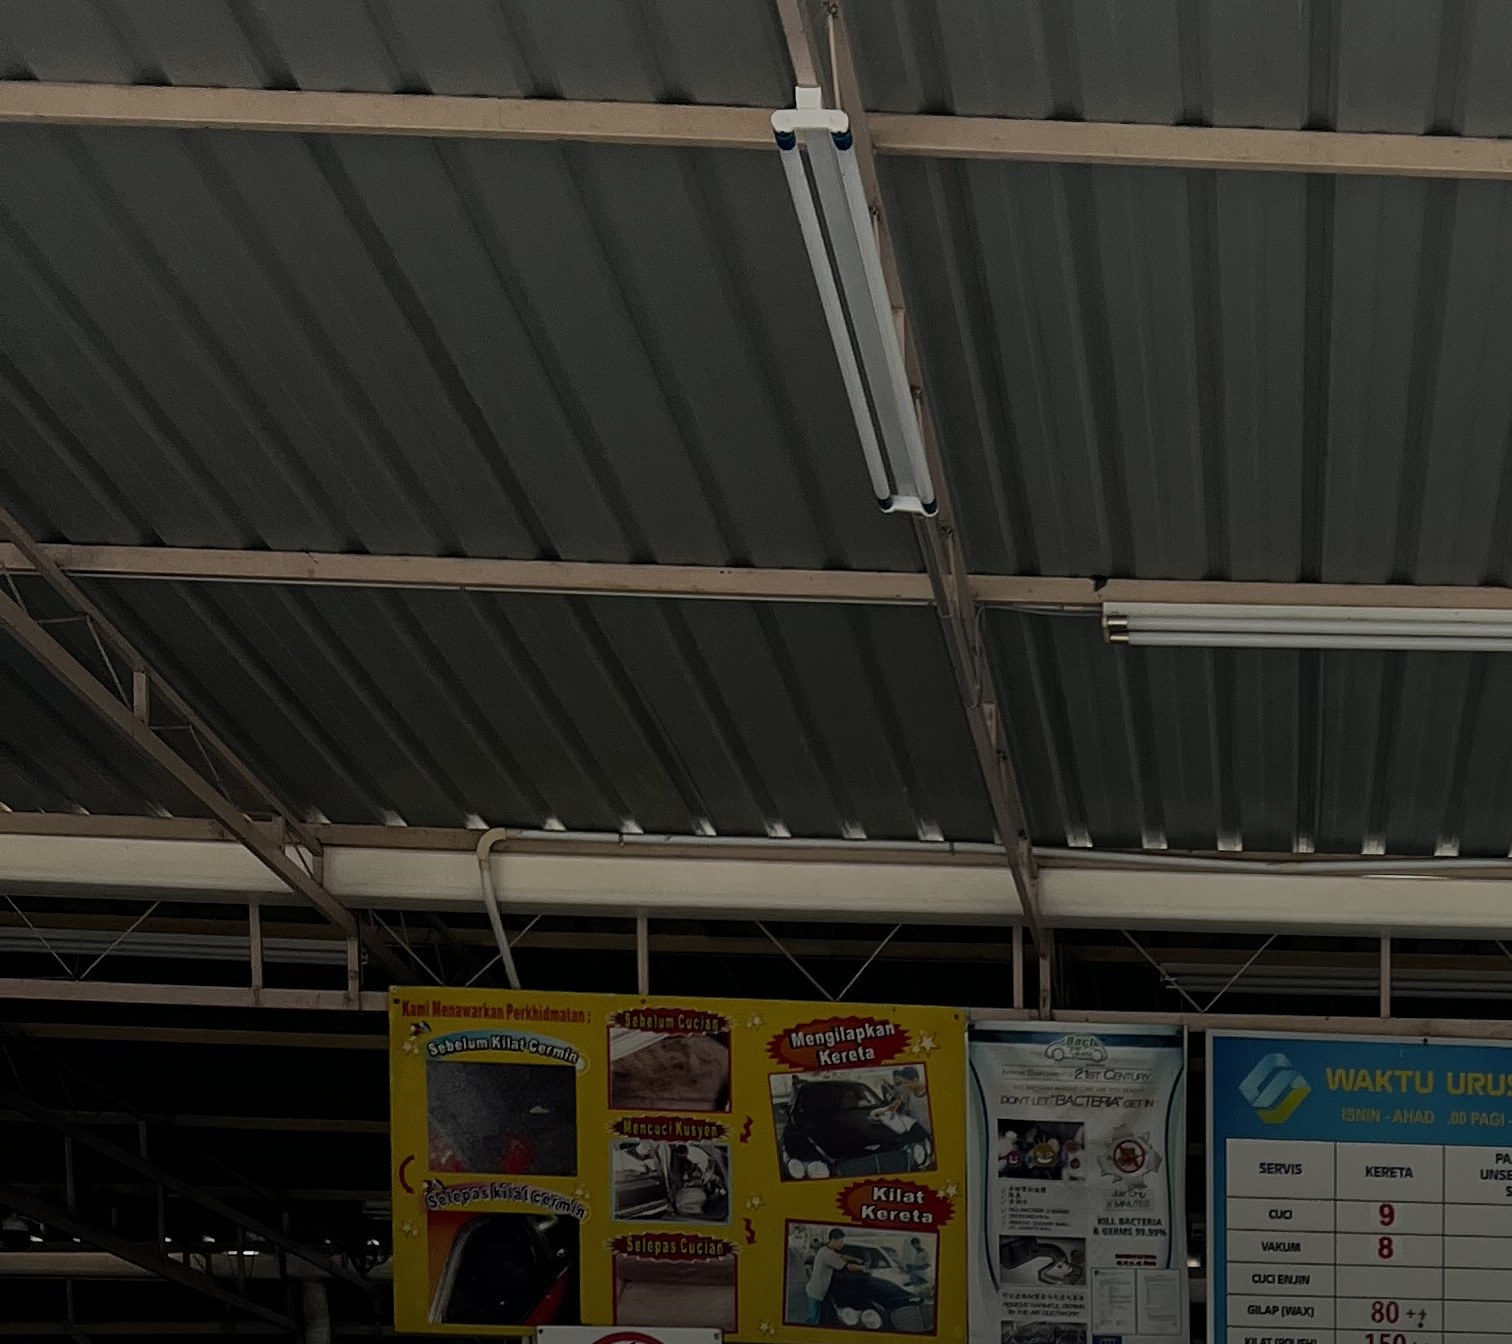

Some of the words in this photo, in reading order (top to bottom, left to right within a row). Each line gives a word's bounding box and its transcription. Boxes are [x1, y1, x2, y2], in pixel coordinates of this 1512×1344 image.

[402, 1000, 430, 1018] Kami
[432, 1001, 503, 1021] Menawarkan
[506, 1003, 585, 1023] Perkhidmatan
[624, 1013, 675, 1031] Sebelum
[677, 1015, 720, 1032] Cucian
[790, 1022, 896, 1049] Mengilapkan
[427, 1036, 489, 1057] Sebelum
[491, 1034, 527, 1051] Kilat
[528, 1040, 579, 1065] Cermin
[818, 1045, 876, 1067] Kereta
[1325, 1067, 1435, 1094] WAKTU
[1341, 1107, 1381, 1122] ISNIN
[1391, 1109, 1435, 1124] AHAD
[1471, 1111, 1505, 1126] PAGI
[622, 1119, 673, 1136] Mencuci
[675, 1121, 718, 1141] Kusyen
[1258, 1162, 1303, 1176] SERVIS
[1364, 1166, 1414, 1179] KERETA
[427, 1184, 489, 1209] Selepas
[872, 1185, 926, 1205] Kilat
[860, 1204, 934, 1225] Kereta
[1097, 1217, 1115, 1226] KILL
[1119, 1217, 1163, 1227] BACTERIA
[1268, 1209, 1293, 1220] CUCI
[1378, 1203, 1396, 1227] 9
[626, 1235, 677, 1255] Selepas
[679, 1237, 724, 1256] Cucian
[1261, 1241, 1302, 1253] VAKUM
[1377, 1235, 1395, 1259] 8
[1251, 1274, 1276, 1285] CUCI
[1277, 1274, 1311, 1286] ENJIN
[1247, 1304, 1280, 1317] GILAP
[1281, 1305, 1316, 1319] (WAX)
[1371, 1300, 1399, 1324] 80
